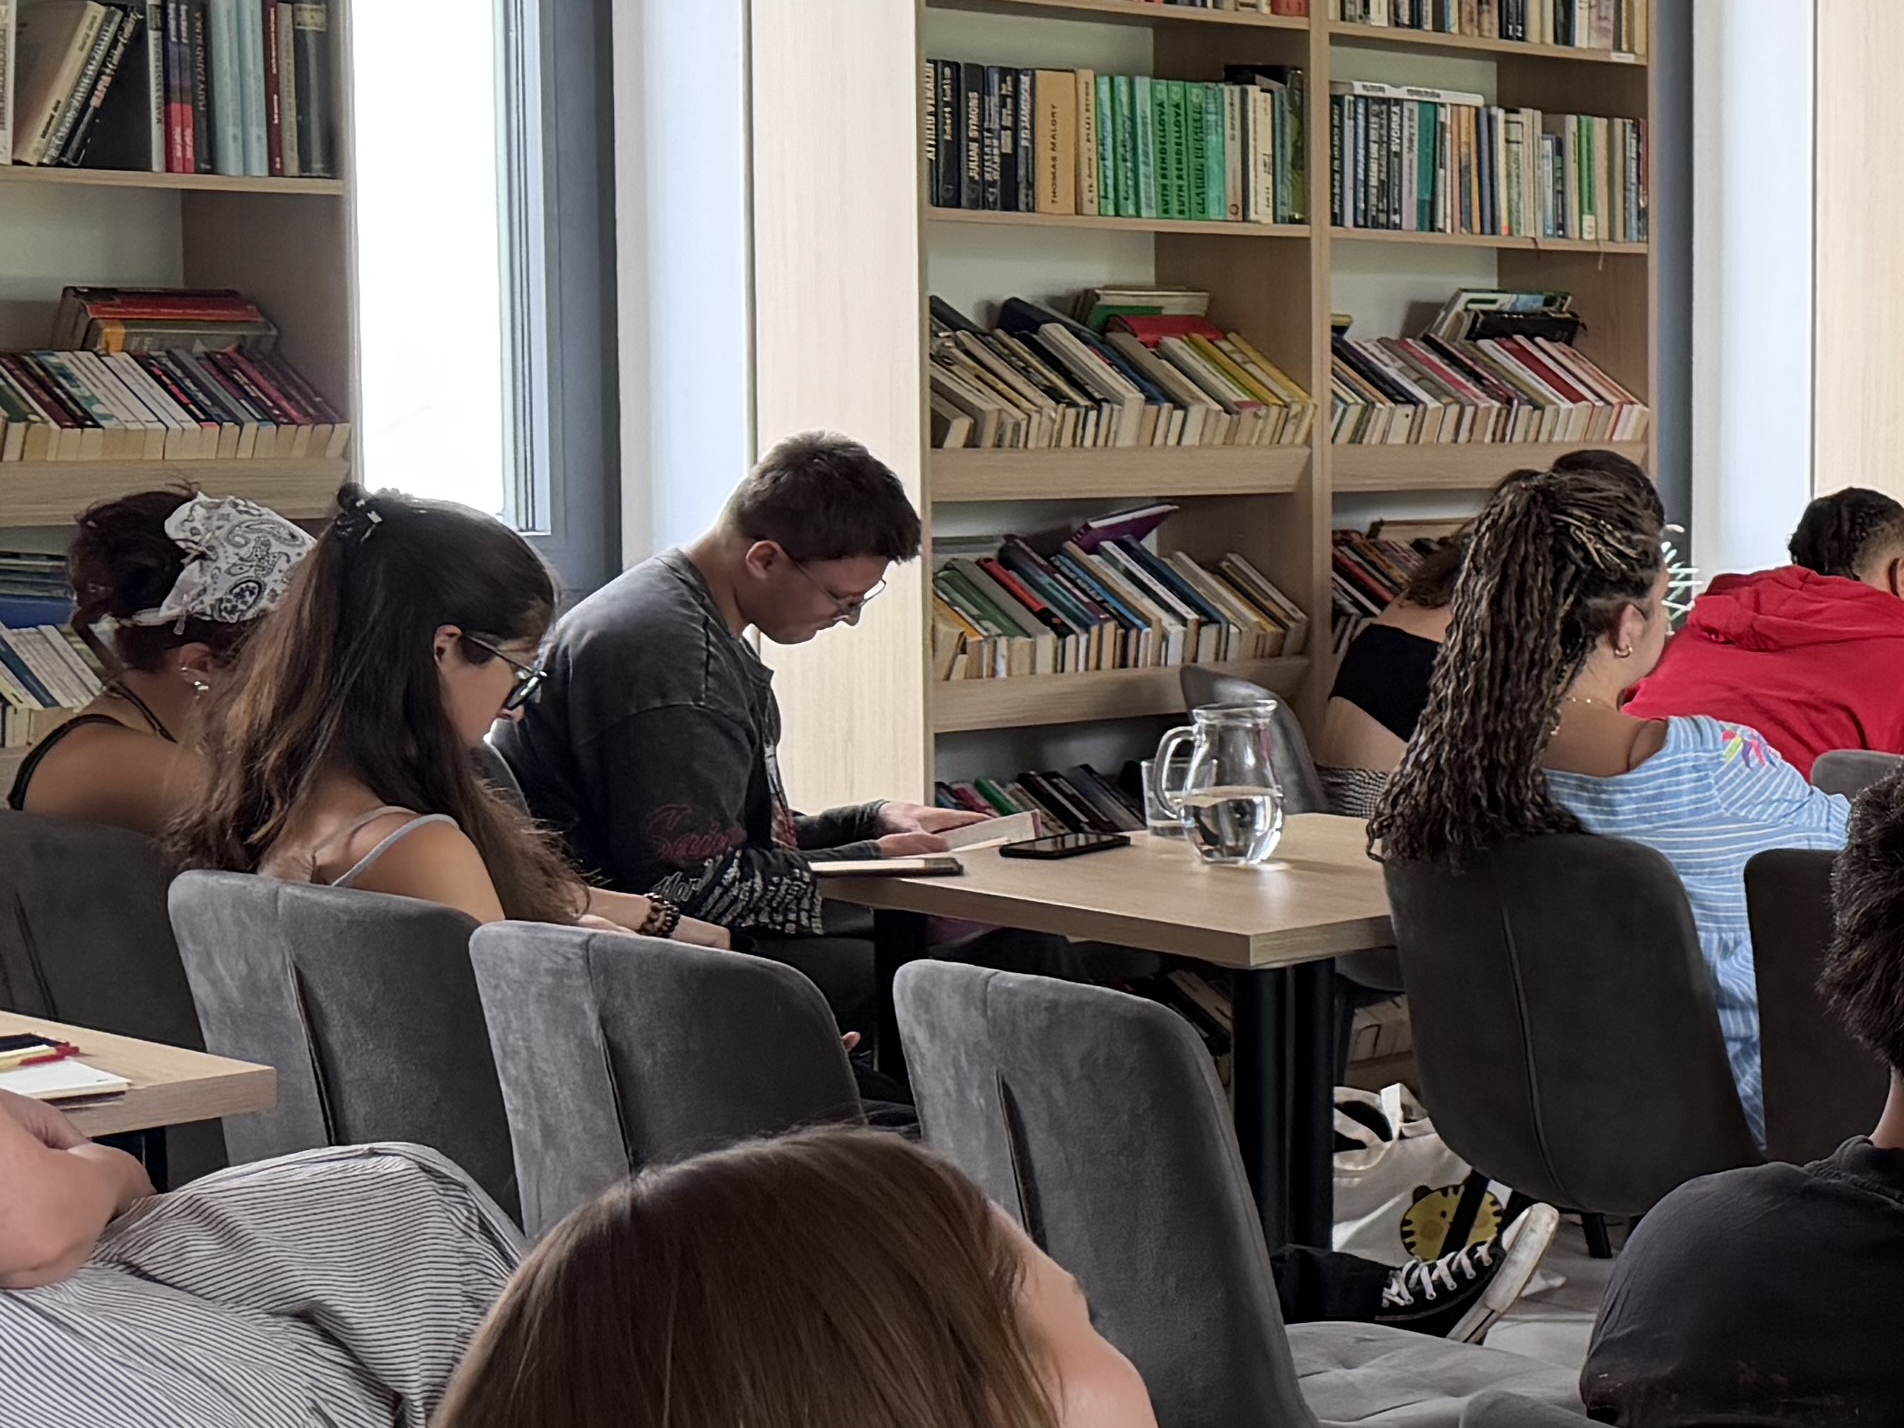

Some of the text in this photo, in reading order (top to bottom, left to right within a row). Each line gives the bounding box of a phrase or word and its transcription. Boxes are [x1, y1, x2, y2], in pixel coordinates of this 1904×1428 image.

[968, 91, 979, 181] JULIAN SYMONS
[1159, 183, 1170, 215] RUTH
[1175, 183, 1186, 216] RUTH
